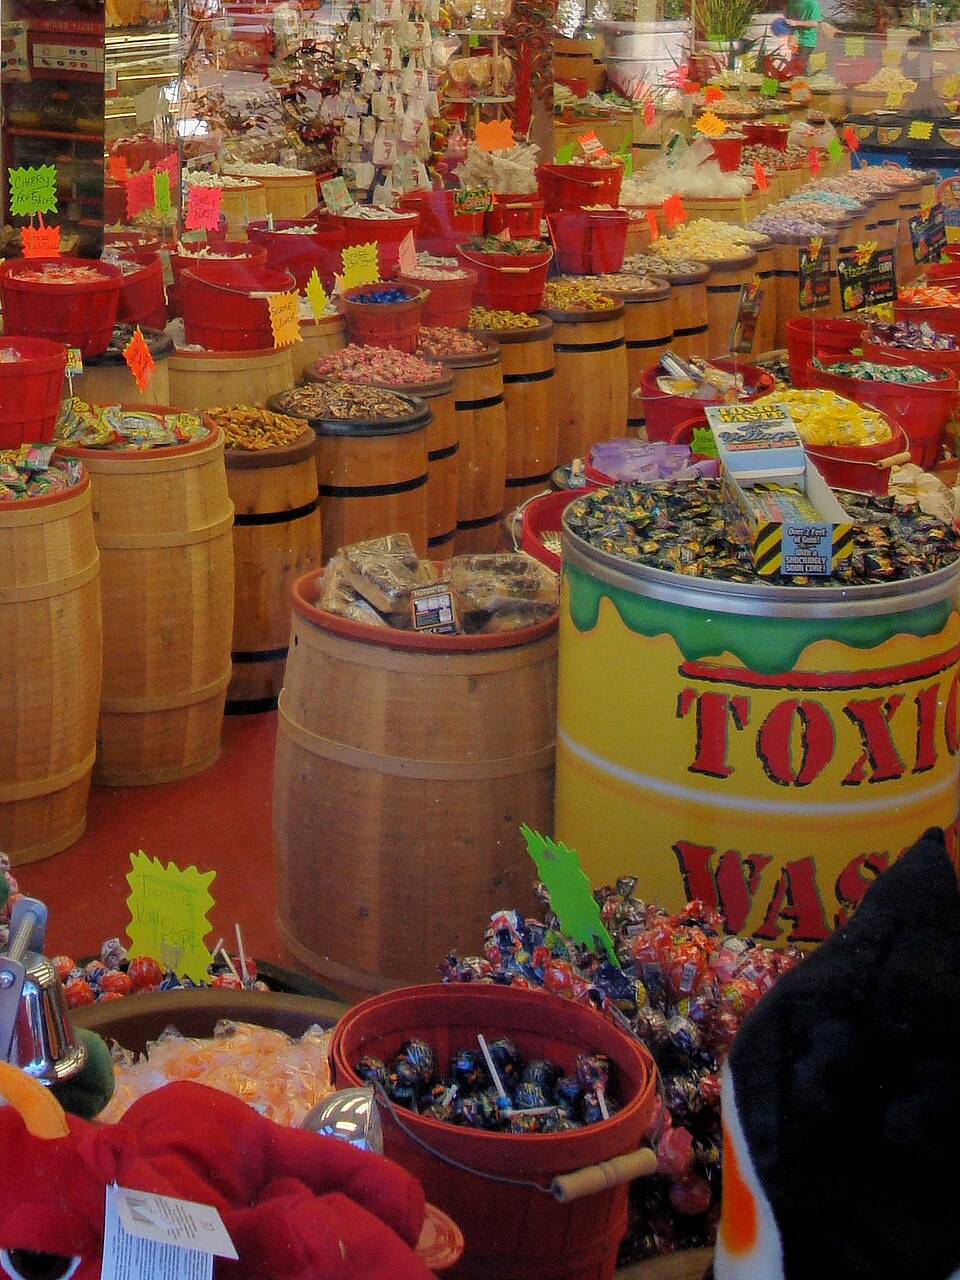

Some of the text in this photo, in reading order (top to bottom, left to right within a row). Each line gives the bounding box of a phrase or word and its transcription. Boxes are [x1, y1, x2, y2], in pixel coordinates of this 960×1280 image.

[788, 527, 806, 536] Over
[811, 527, 827, 536] Feet
[672, 839, 909, 943] WAS
